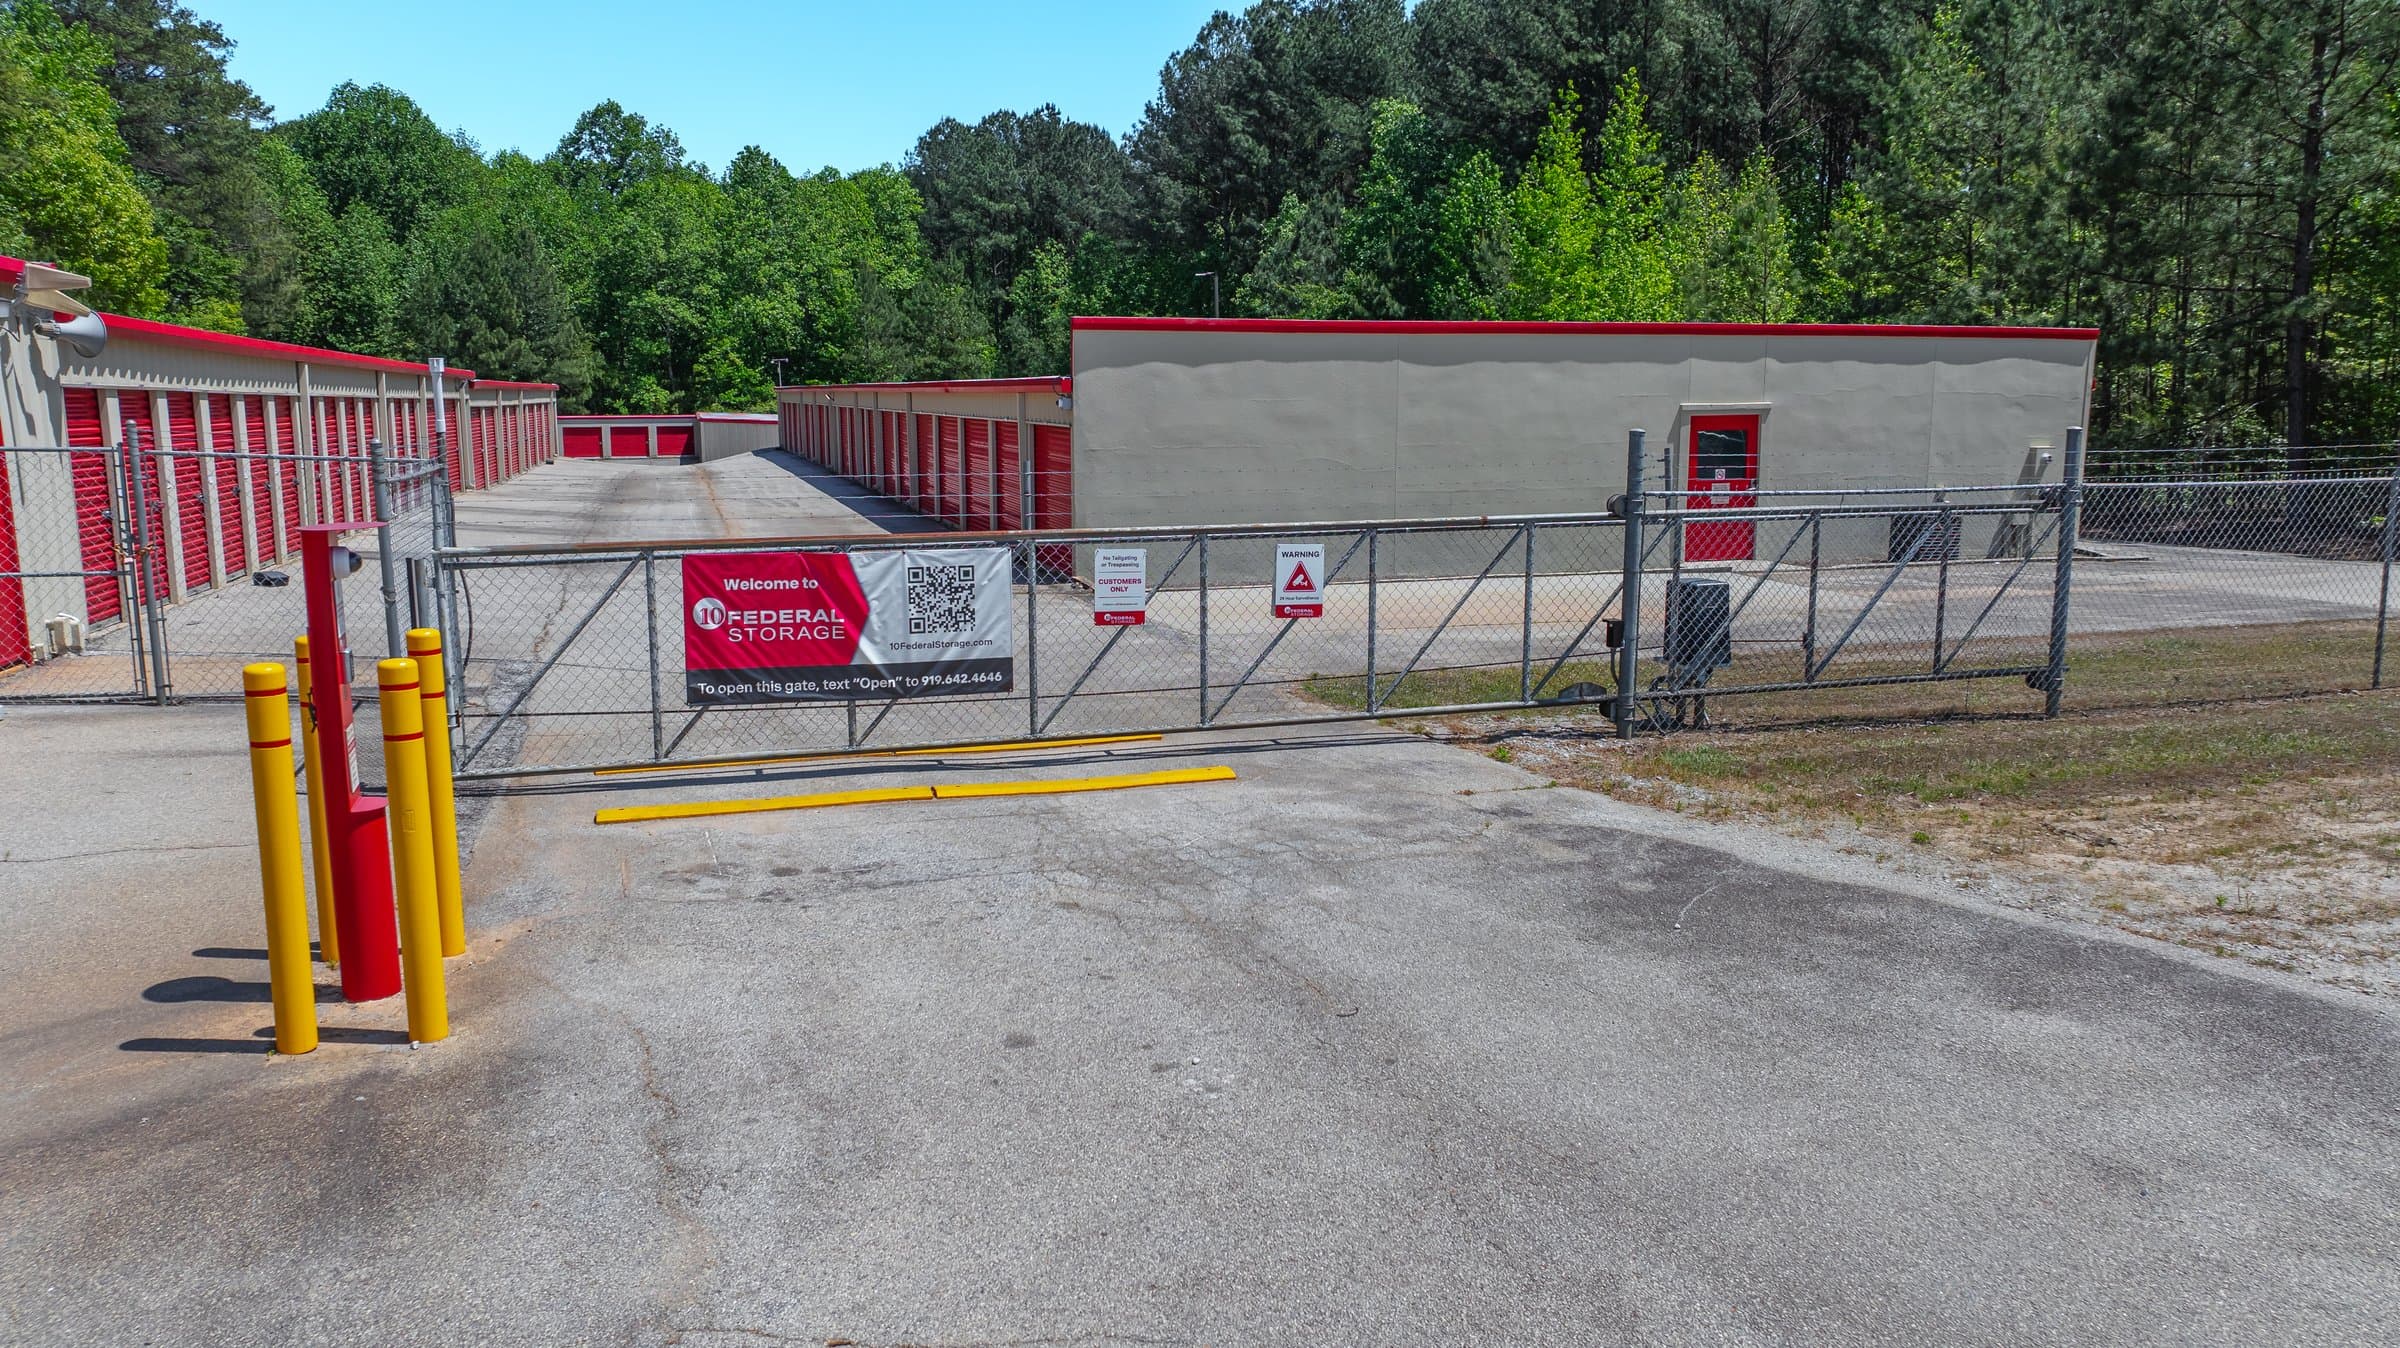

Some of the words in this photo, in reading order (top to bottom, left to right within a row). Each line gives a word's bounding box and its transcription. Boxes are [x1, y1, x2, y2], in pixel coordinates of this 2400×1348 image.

[724, 578, 799, 591] Welcome
[802, 577, 818, 589] to
[699, 607, 725, 625] 10
[727, 609, 845, 625] FEDERAL
[728, 625, 846, 642] STORAGE
[889, 639, 993, 650] 10FederalStorage.com
[698, 682, 715, 694] To
[718, 683, 753, 696] open
[756, 680, 782, 693] this
[785, 680, 820, 693] gate,
[822, 679, 850, 690] text
[905, 676, 919, 687] to
[921, 672, 1002, 686] 919.642.4646
